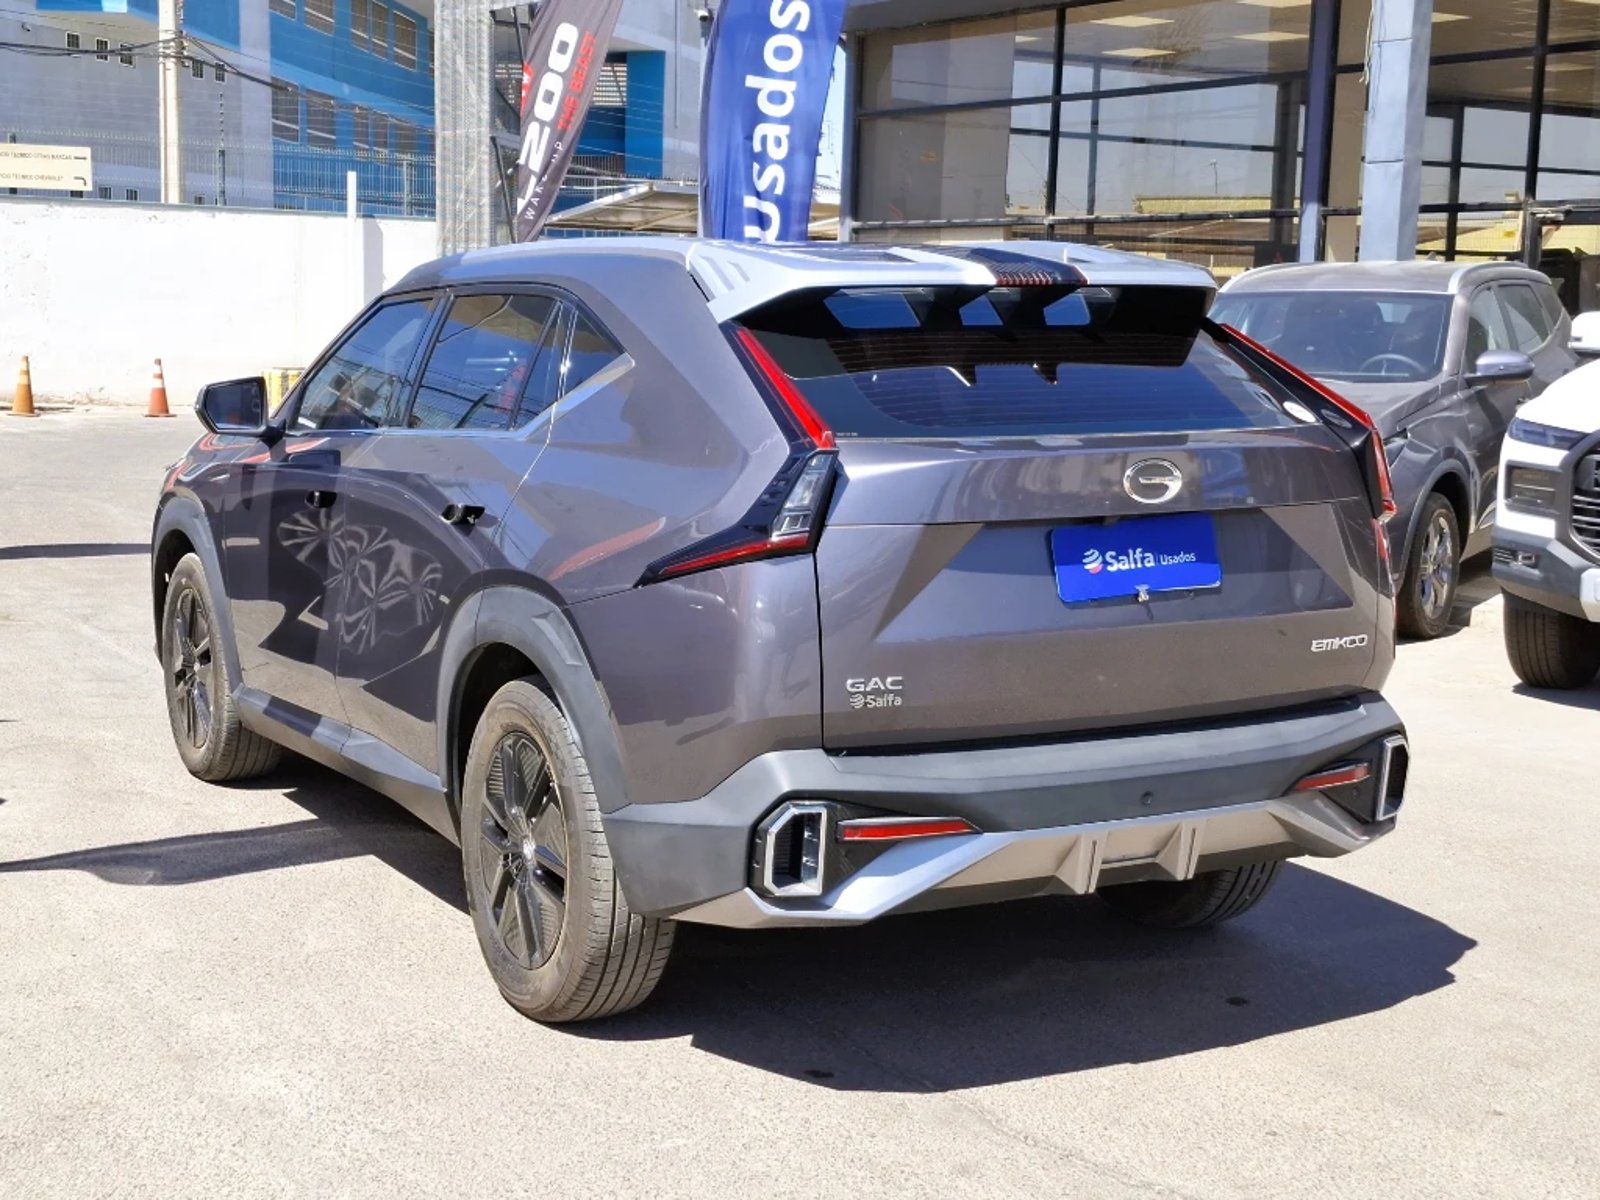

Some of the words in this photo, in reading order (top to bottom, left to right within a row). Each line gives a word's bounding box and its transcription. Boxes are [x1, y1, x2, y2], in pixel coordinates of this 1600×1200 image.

[557, 95, 578, 130] THE
[570, 31, 597, 92] BEAST
[743, 0, 811, 242] Usados
[1105, 548, 1155, 572] Salfa
[1160, 551, 1196, 565] Usados
[1310, 633, 1368, 652] EMKOO
[846, 676, 903, 692] GAC
[866, 693, 902, 708] Salfa
